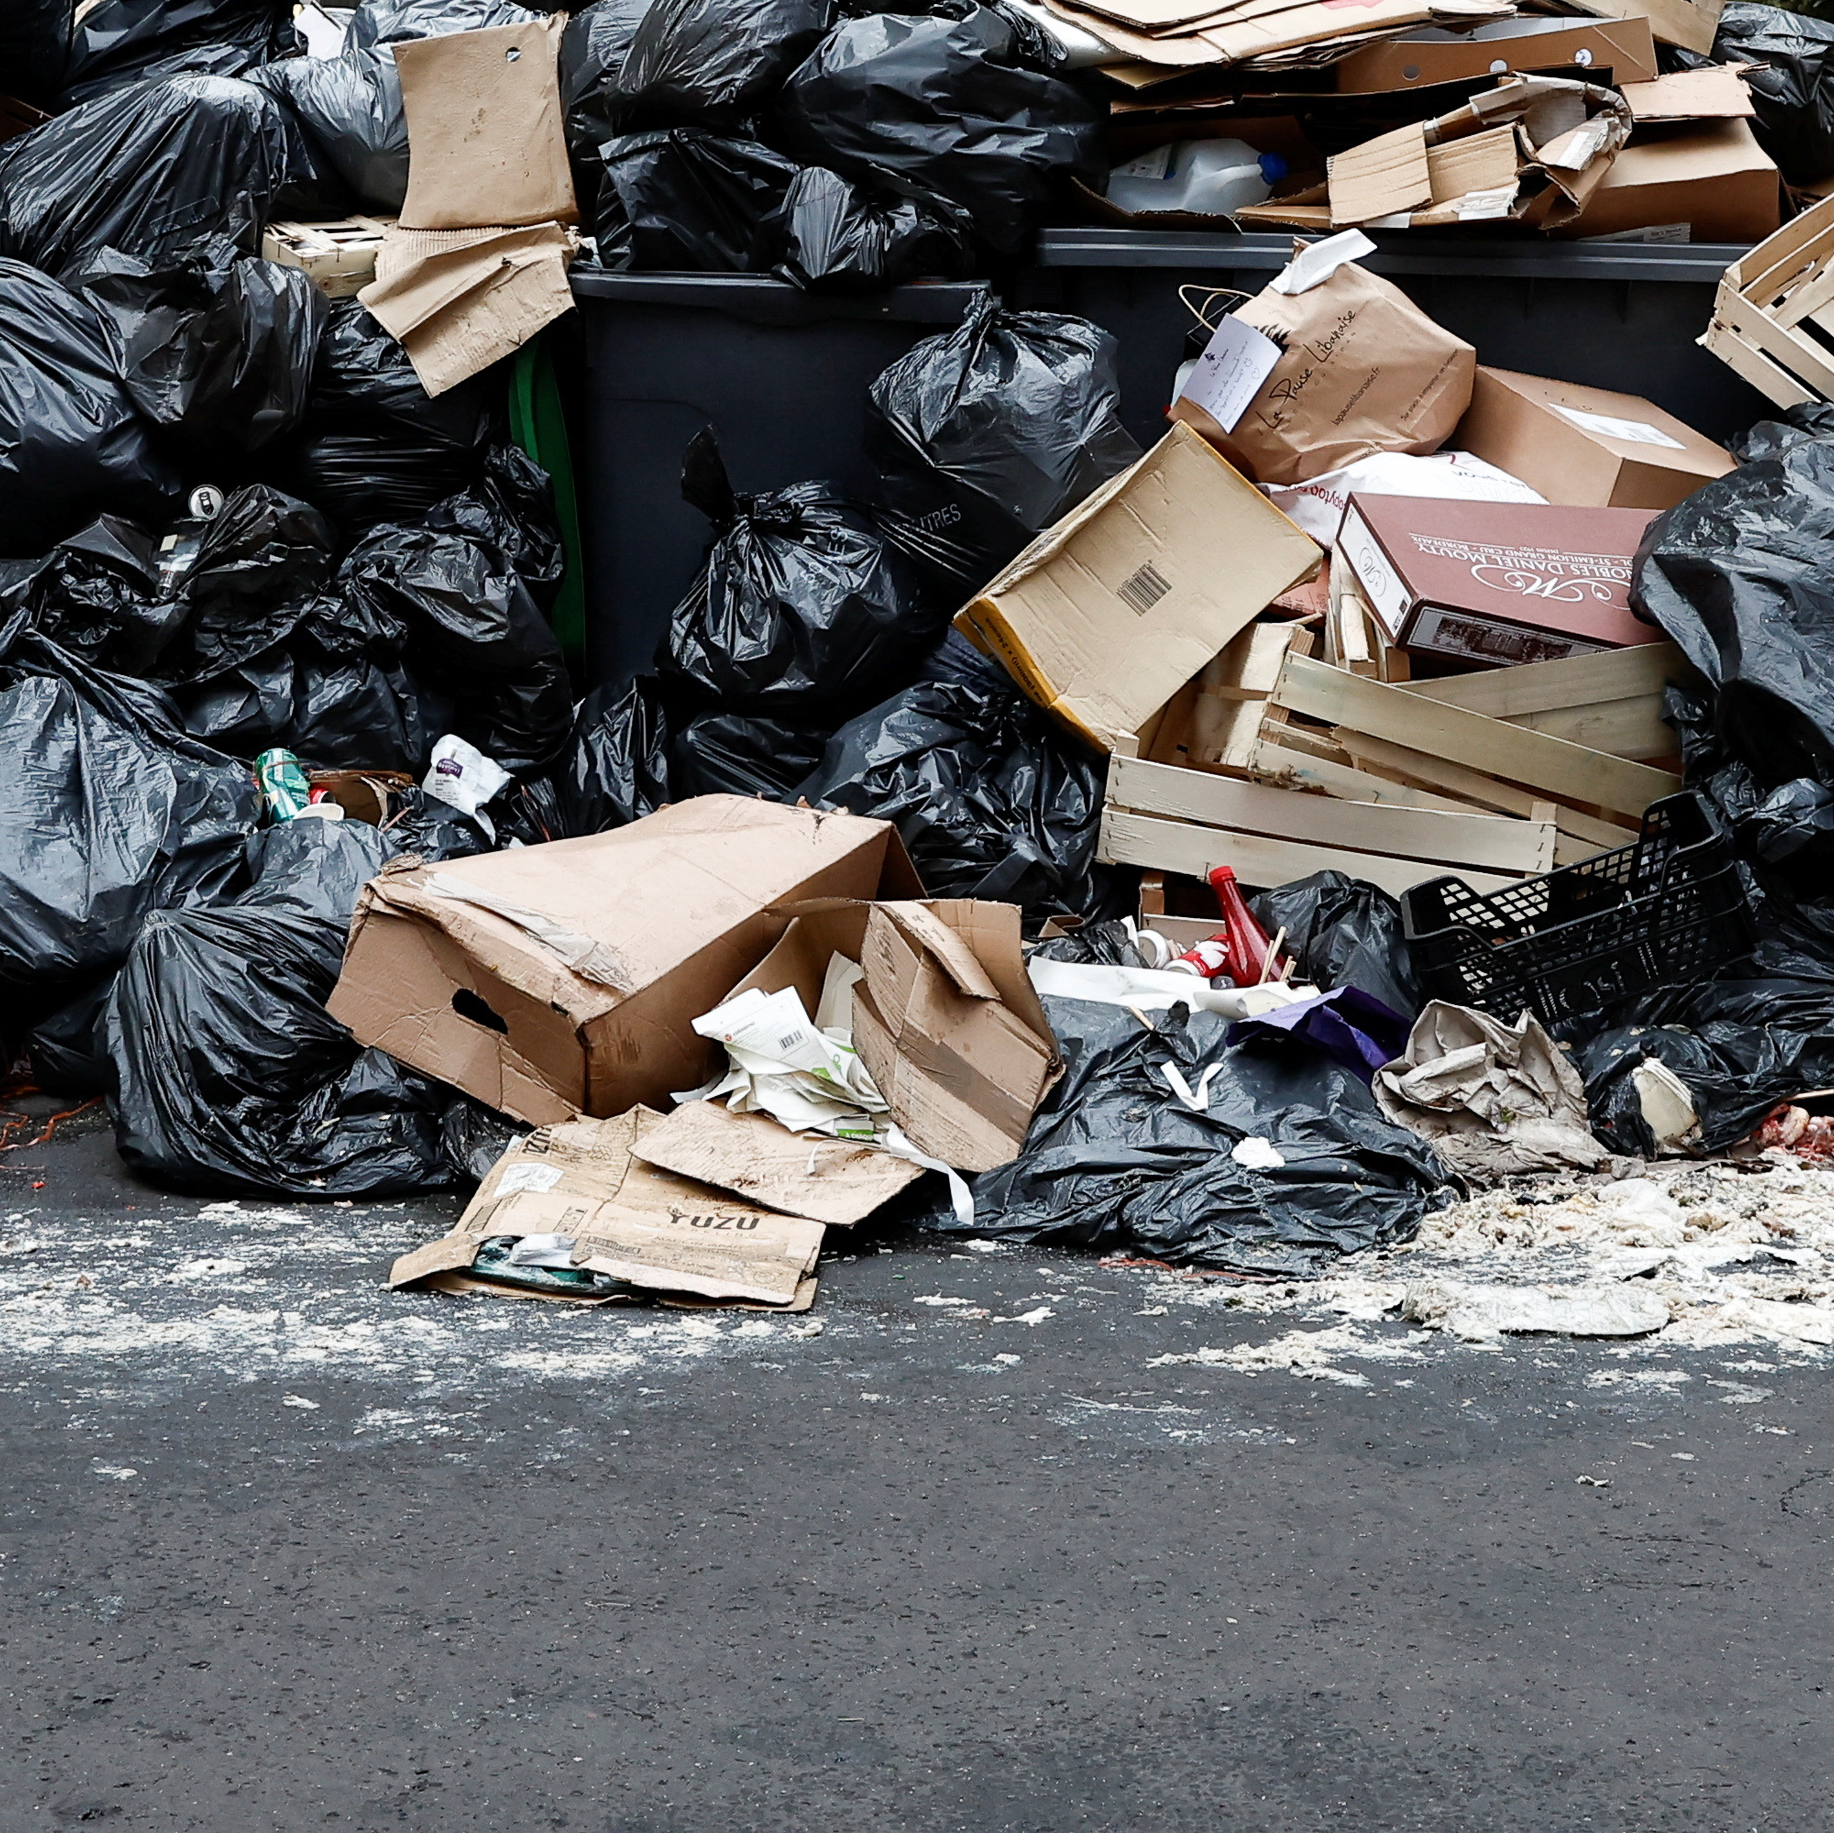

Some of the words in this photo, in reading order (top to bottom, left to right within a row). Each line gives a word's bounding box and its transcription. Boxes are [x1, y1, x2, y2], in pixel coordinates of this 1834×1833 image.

[1303, 309, 1356, 363] Libanaise
[1269, 368, 1313, 406] Pause
[1331, 367, 1380, 426] lapauselibanaise.fr
[1256, 408, 1284, 430] La
[1411, 535, 1468, 551] BORDEAUX
[1480, 546, 1503, 555] CRU
[1418, 543, 1487, 565] MOUTY
[1505, 549, 1545, 560] GRAND
[1491, 555, 1565, 575] DANIEL
[669, 1214, 761, 1231] YUZU
